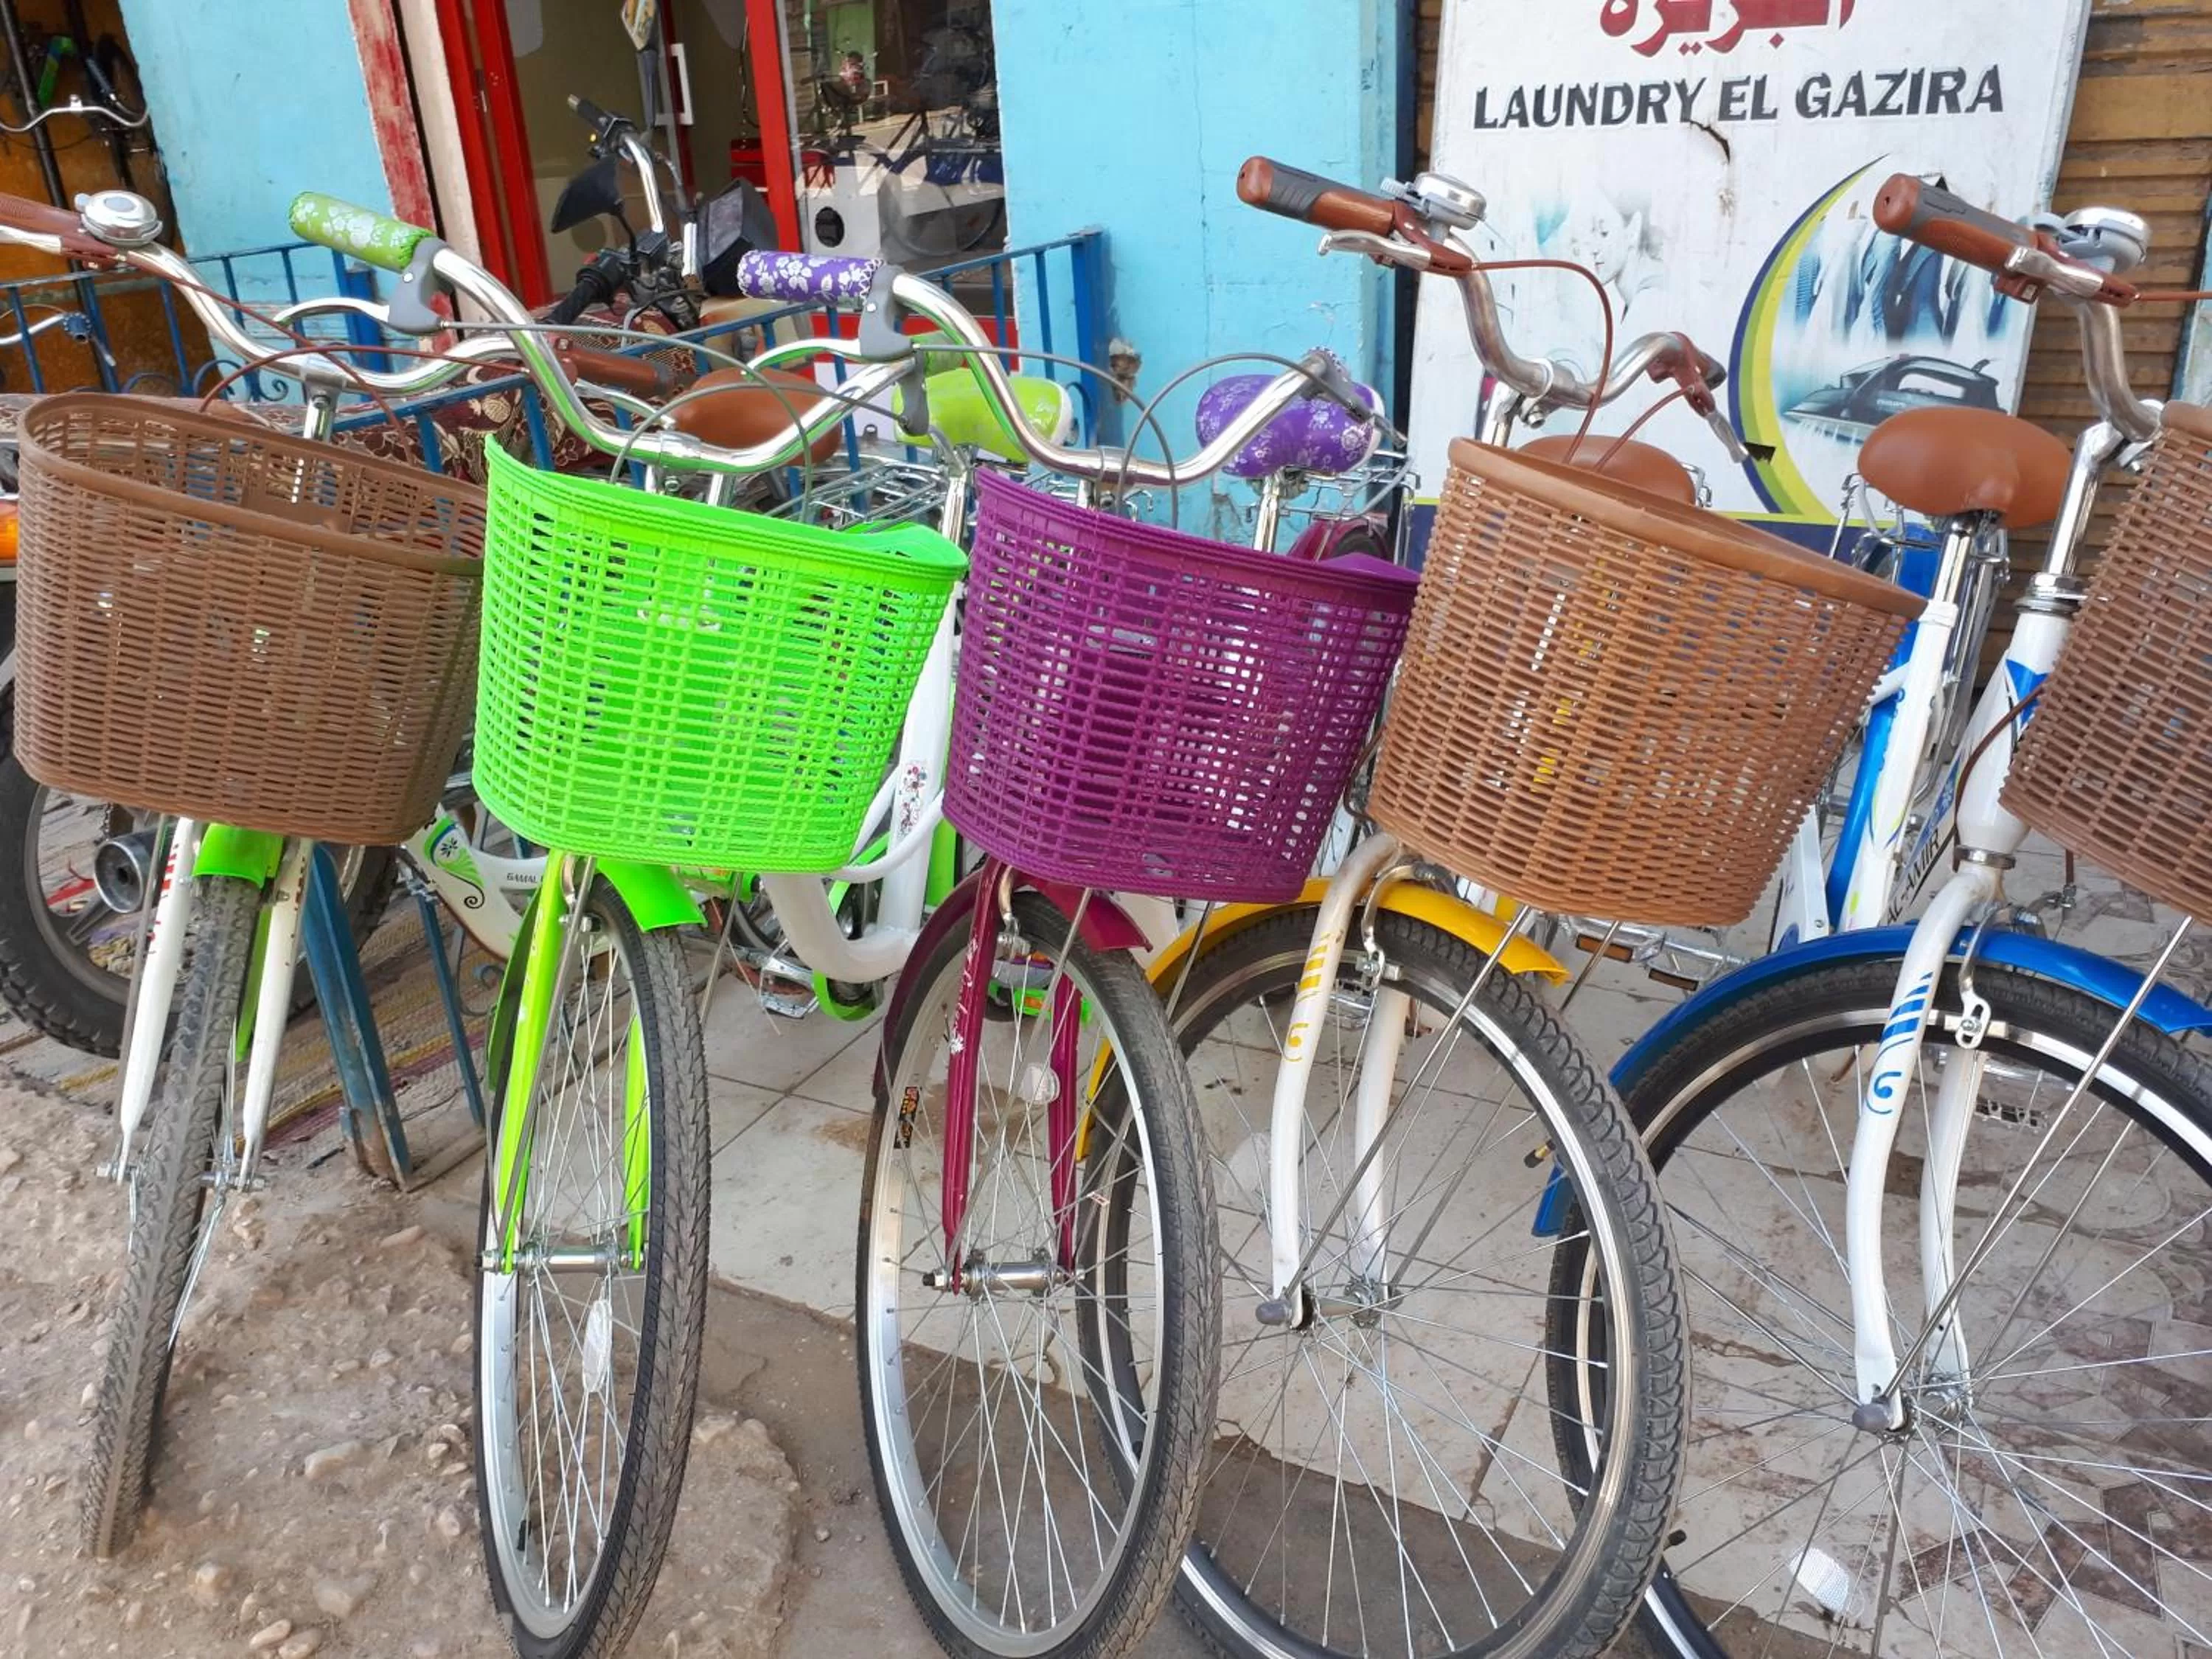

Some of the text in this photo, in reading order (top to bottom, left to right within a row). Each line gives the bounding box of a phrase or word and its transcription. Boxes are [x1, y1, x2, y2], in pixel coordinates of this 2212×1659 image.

[1474, 64, 2004, 130] LAUNDRY EL GAZIRA
